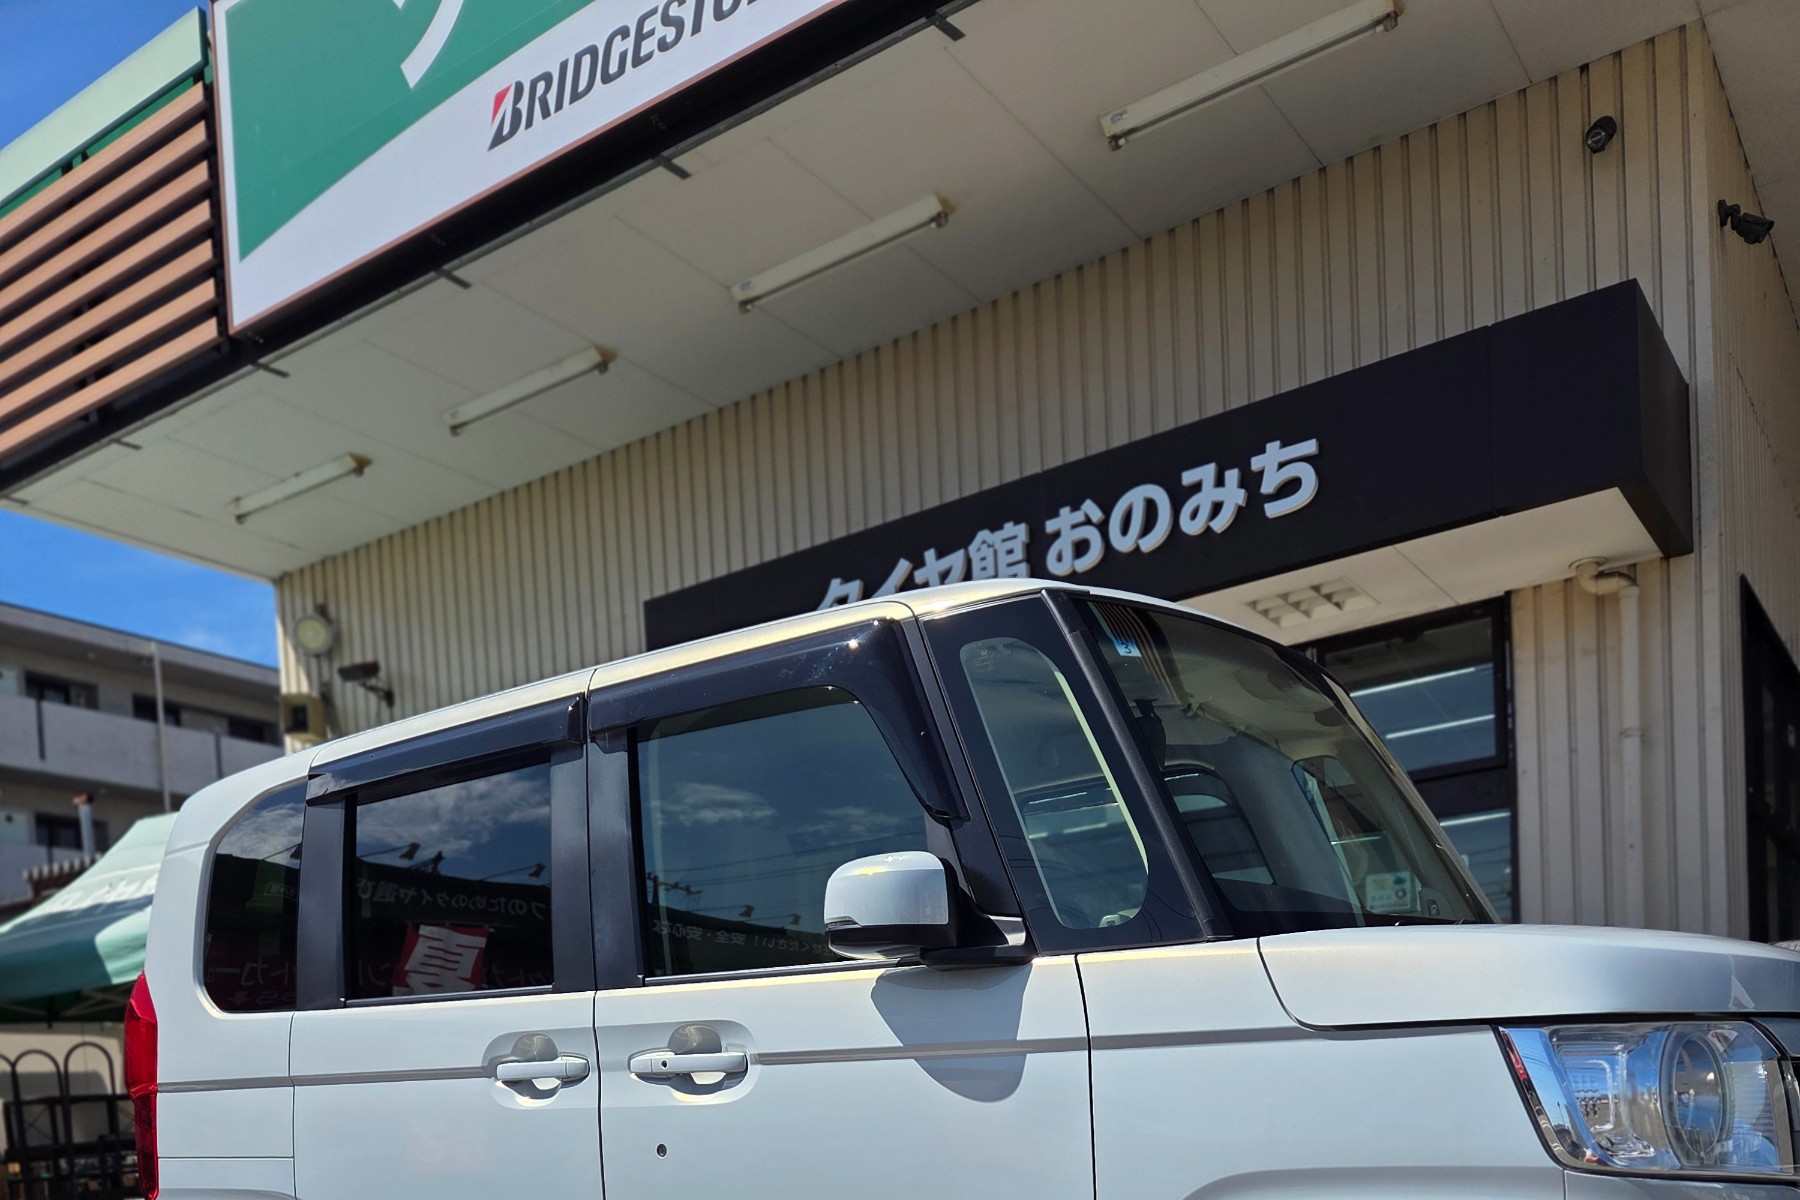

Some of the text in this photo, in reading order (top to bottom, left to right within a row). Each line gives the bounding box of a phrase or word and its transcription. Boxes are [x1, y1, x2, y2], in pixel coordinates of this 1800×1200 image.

[487, 0, 757, 151] BRIDGEST
[1045, 438, 1320, 577] おのみち
